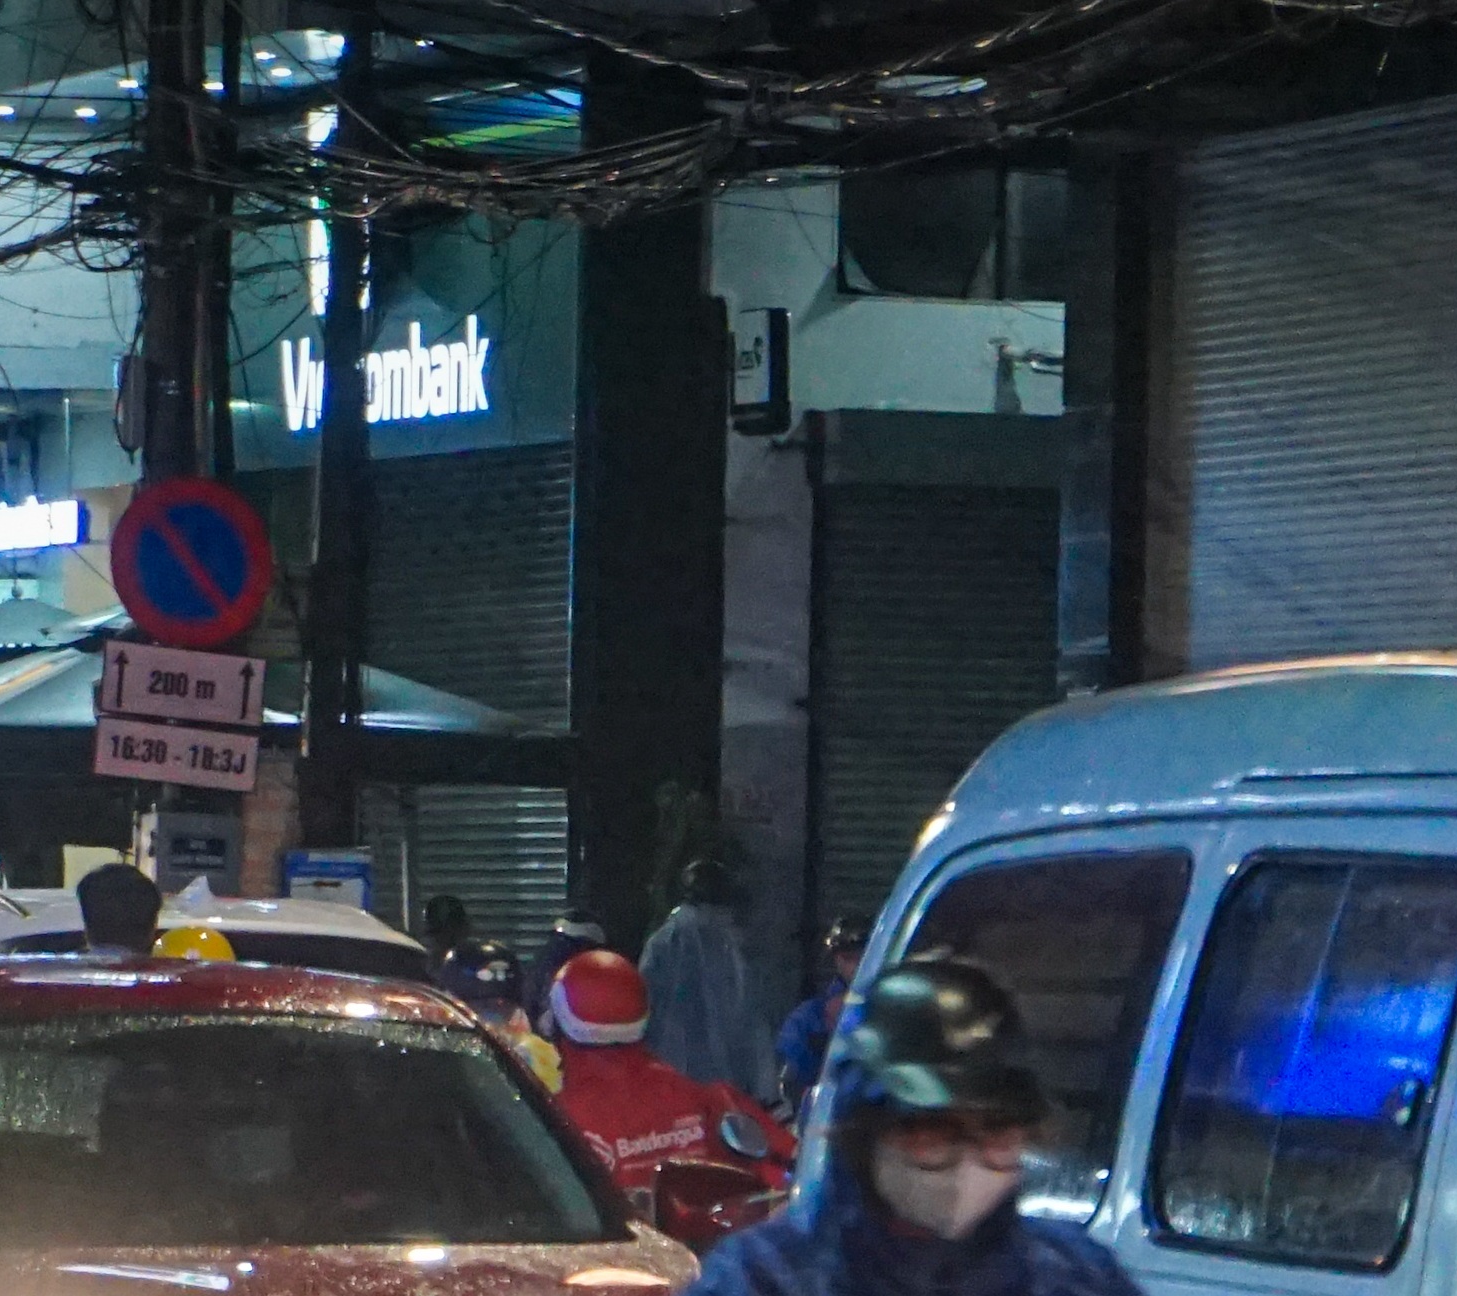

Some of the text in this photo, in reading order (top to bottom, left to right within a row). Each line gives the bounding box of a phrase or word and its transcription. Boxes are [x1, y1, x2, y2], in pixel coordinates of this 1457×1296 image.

[281, 314, 490, 431] Viombank
[148, 670, 216, 699] 200 m
[111, 735, 168, 765] 16:30
